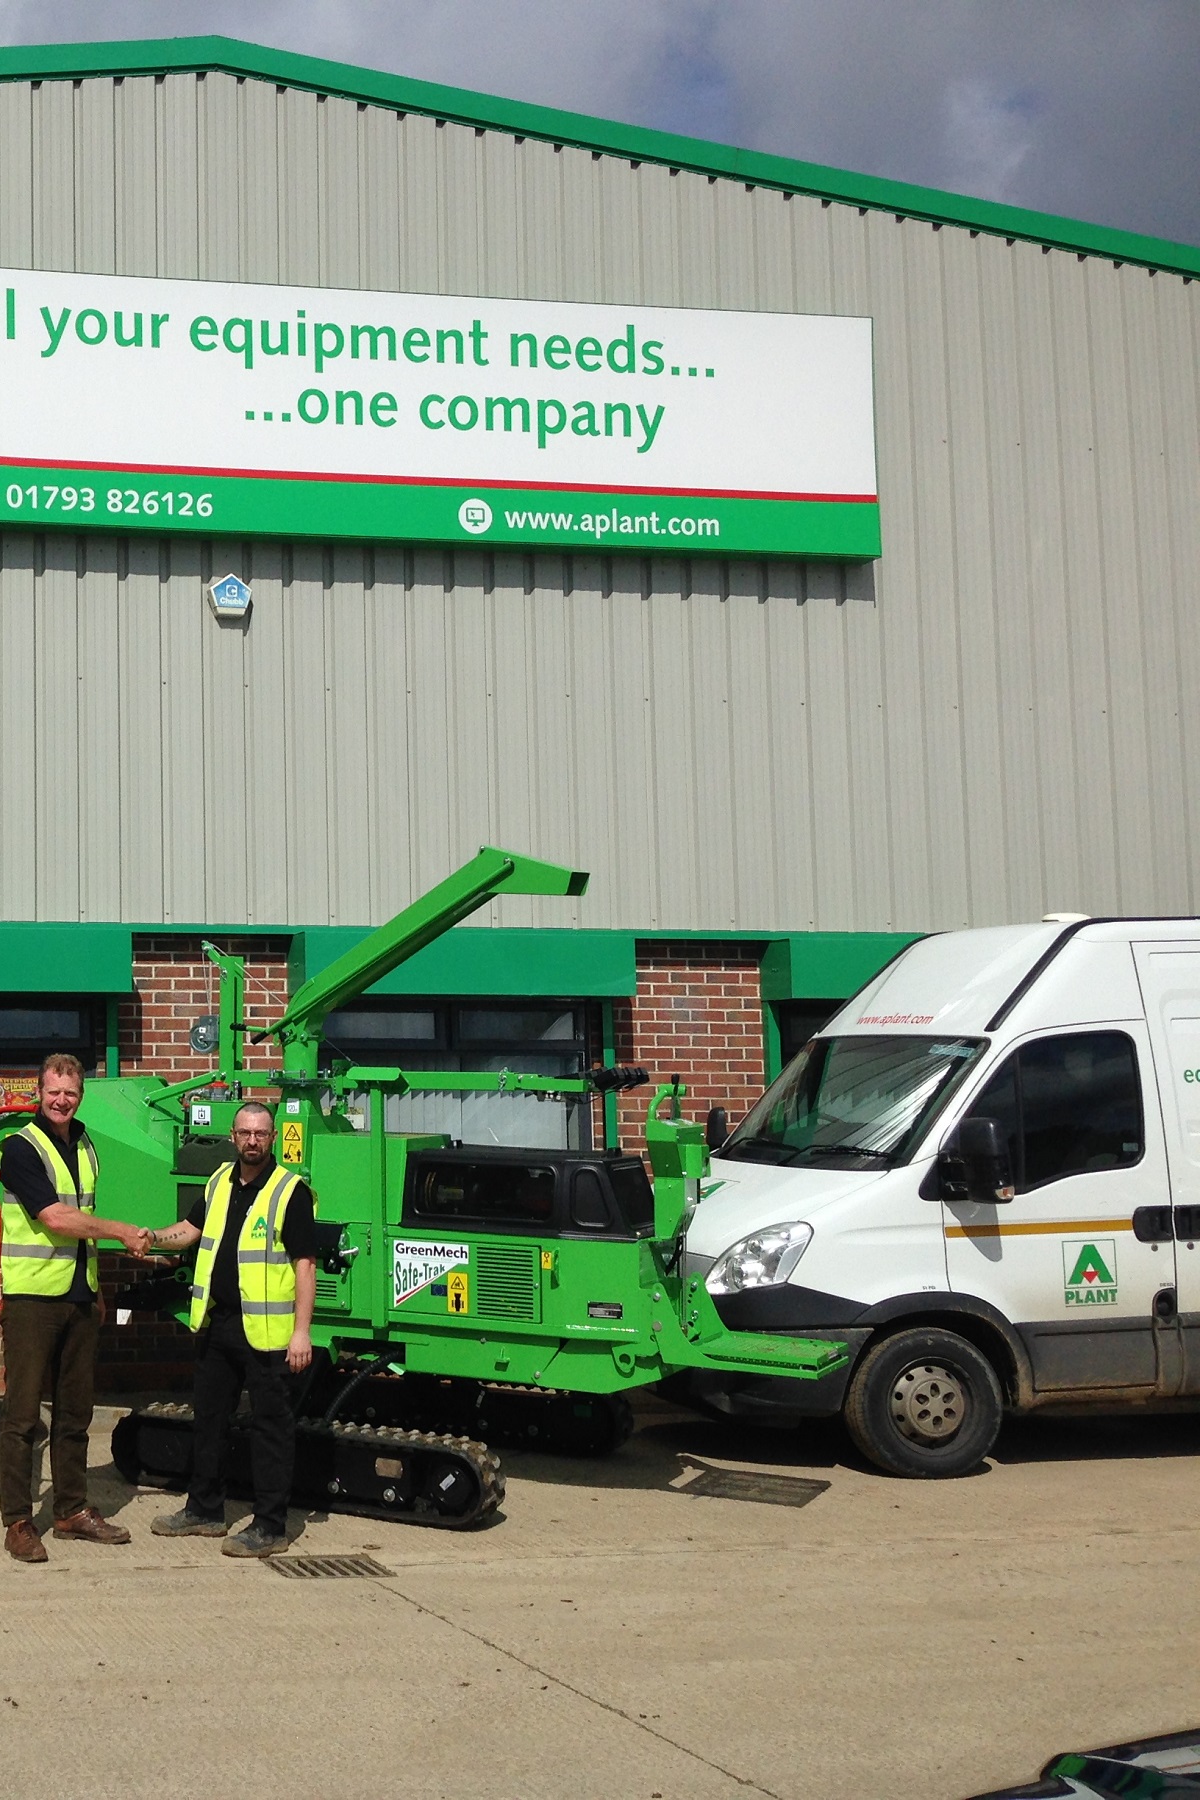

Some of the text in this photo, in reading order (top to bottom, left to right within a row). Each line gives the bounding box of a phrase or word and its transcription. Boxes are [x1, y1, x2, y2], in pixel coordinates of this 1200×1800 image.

[40, 306, 170, 358] your
[189, 309, 489, 373] equipment
[510, 324, 715, 378] needs...
[245, 388, 665, 454] ...one company
[6, 484, 213, 517] 01793 826126
[504, 508, 720, 539] www.aplant.com
[856, 1012, 934, 1027] www.aplant.com
[395, 1242, 468, 1259] GreenMech
[1067, 1244, 1115, 1285] A
[395, 1260, 446, 1296] Safe-Trak
[1064, 1288, 1118, 1305] PLANT
